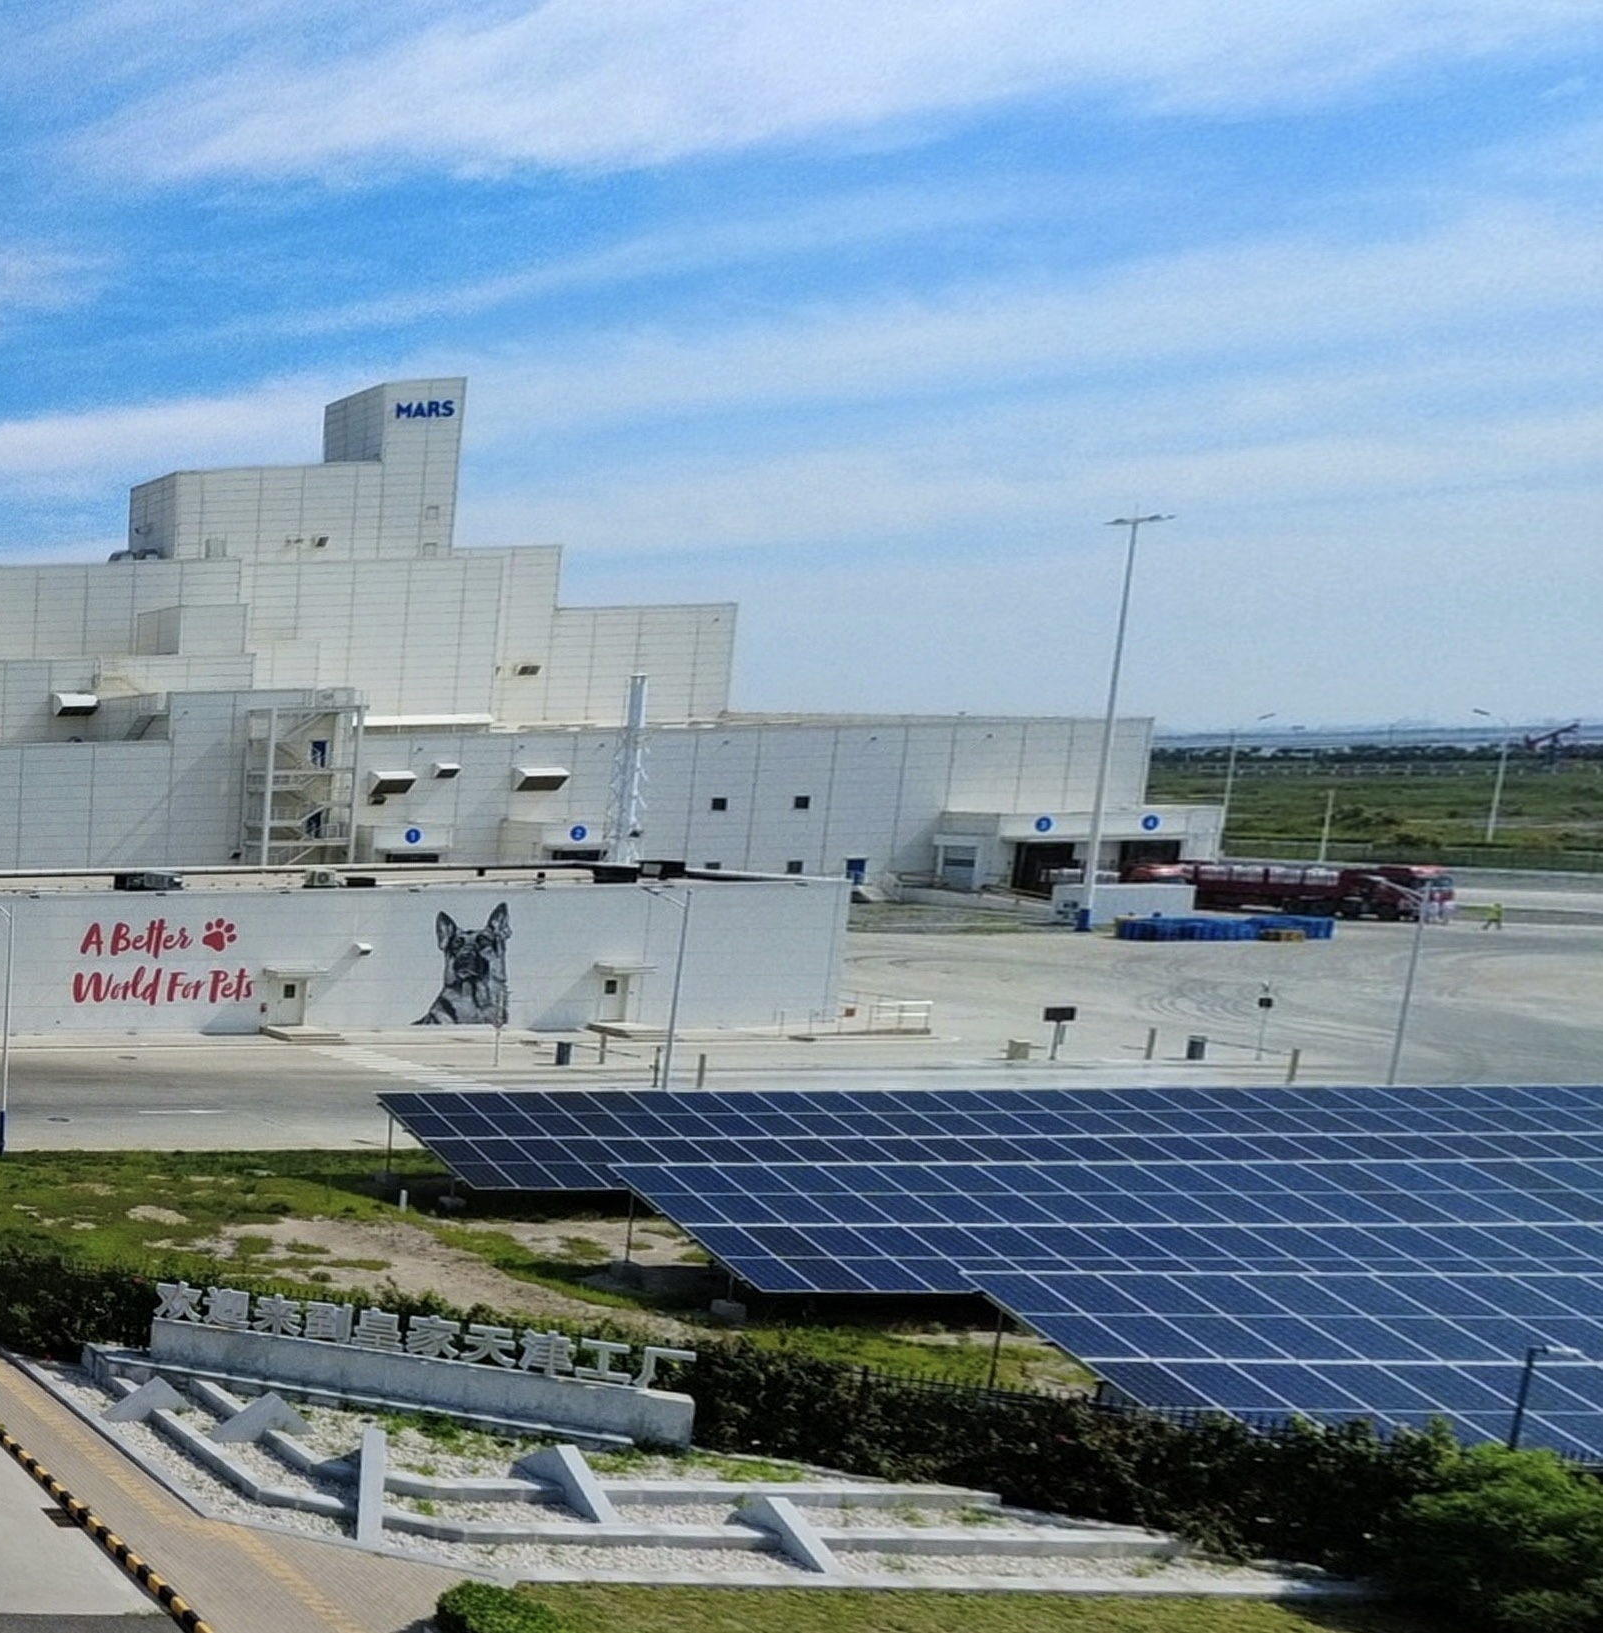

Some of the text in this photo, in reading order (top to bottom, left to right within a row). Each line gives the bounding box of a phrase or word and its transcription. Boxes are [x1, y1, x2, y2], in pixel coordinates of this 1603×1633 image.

[395, 400, 455, 419] MARS
[80, 918, 194, 959] A Better
[73, 965, 254, 1006] World For Pets
[152, 1280, 697, 1389] 欢迎来到皇家天津工厂
